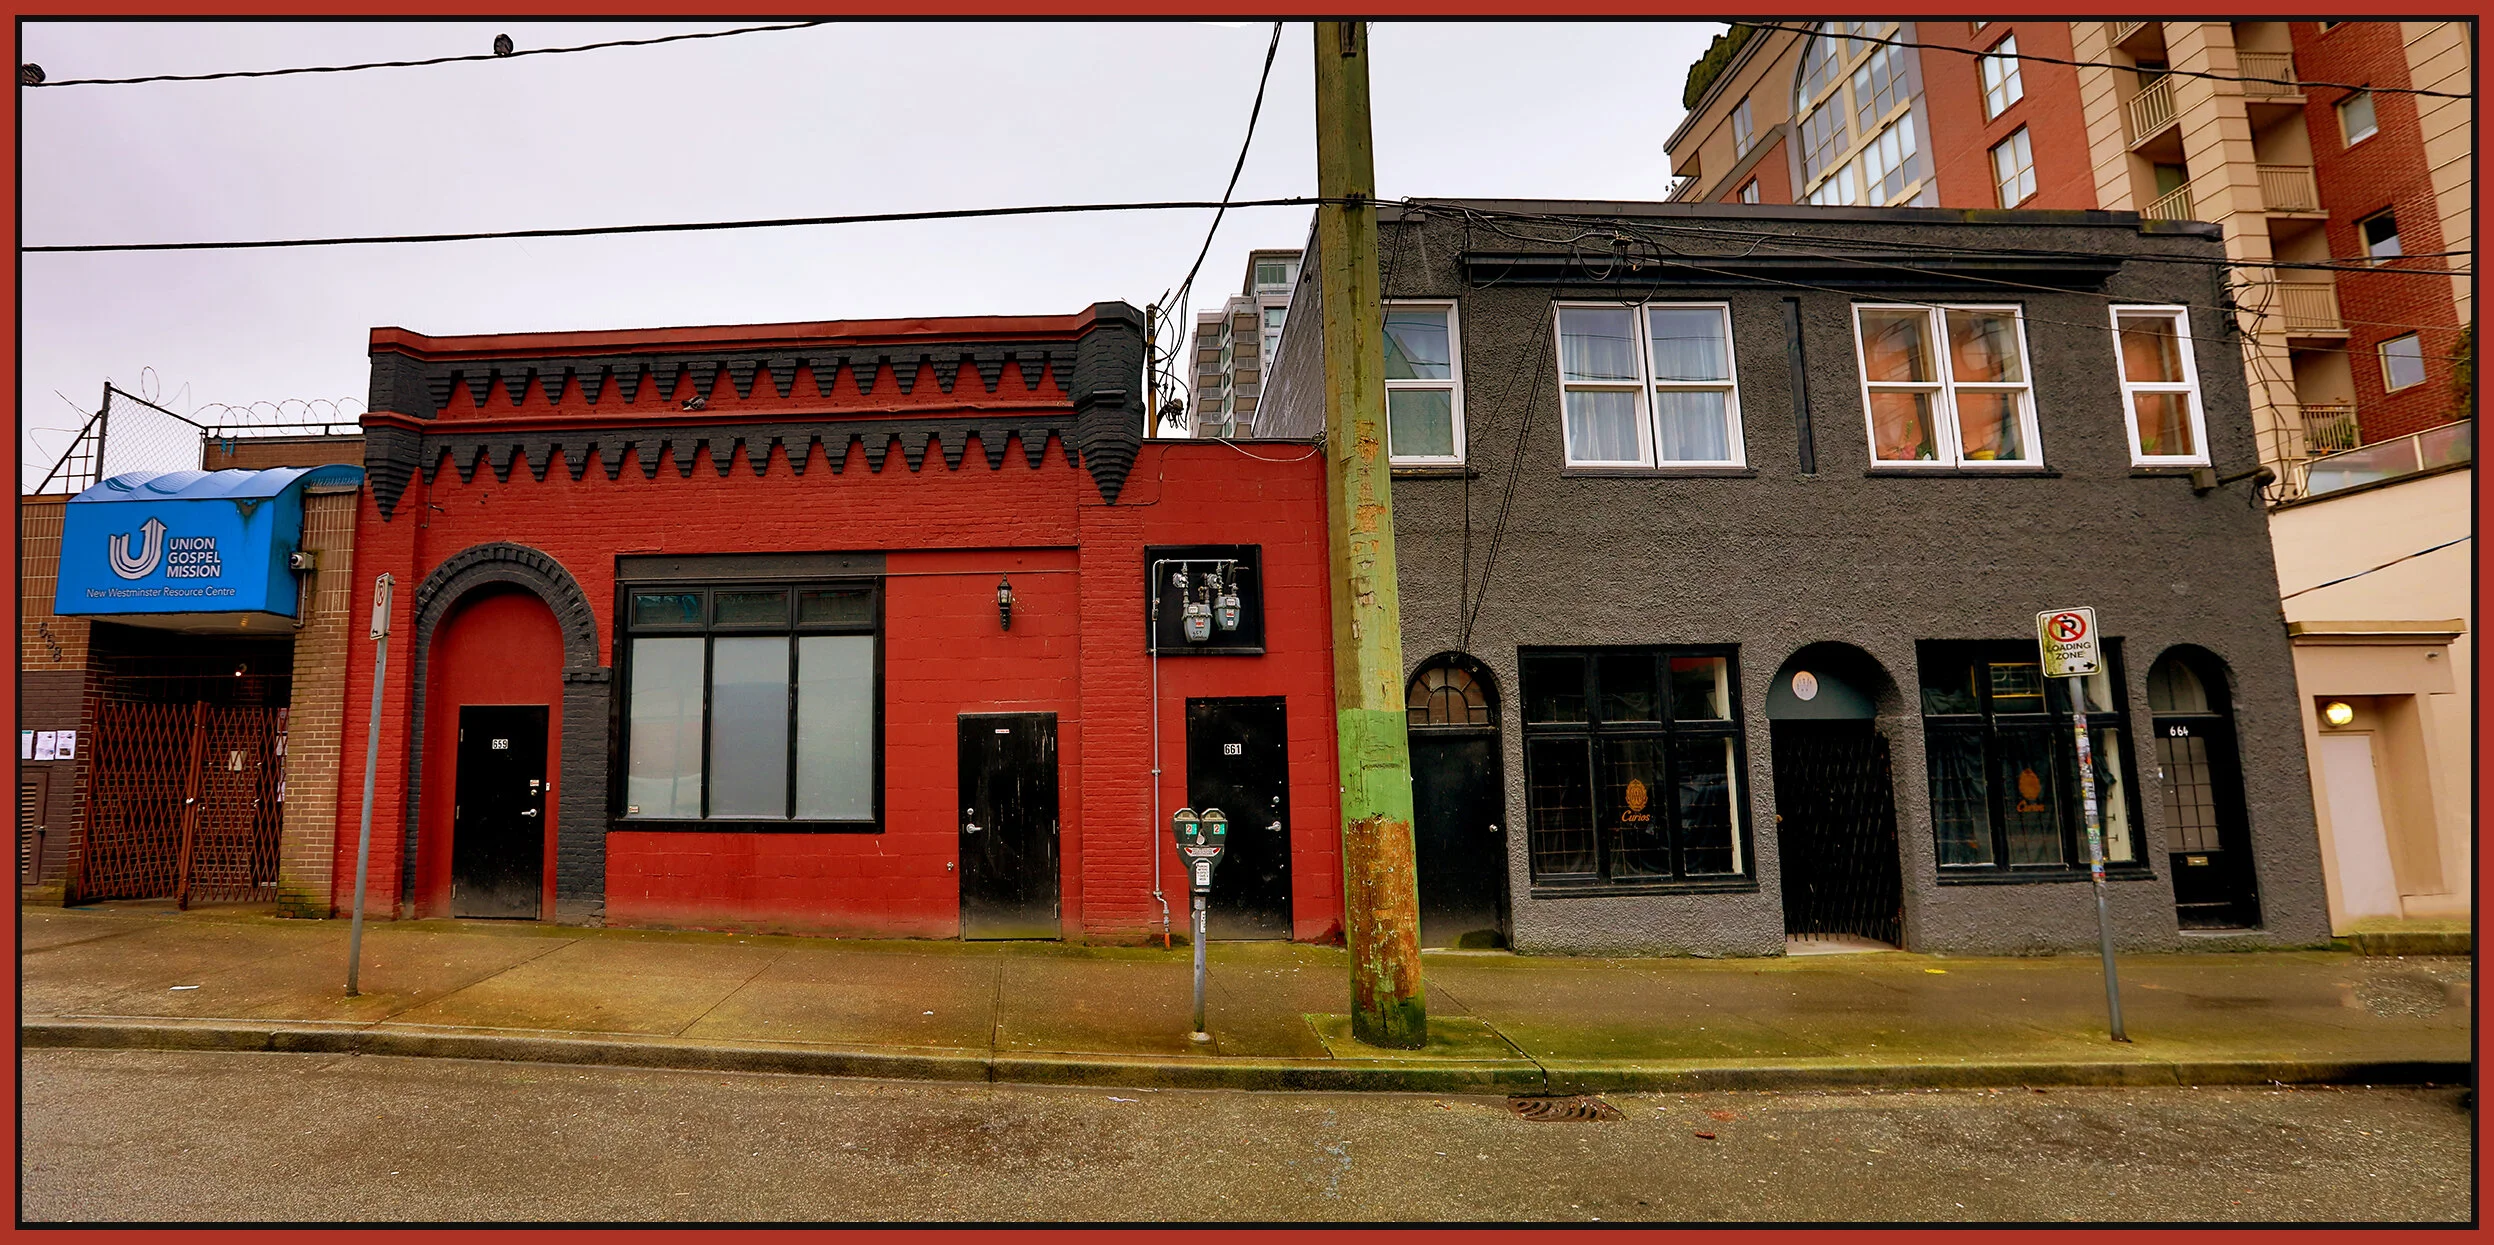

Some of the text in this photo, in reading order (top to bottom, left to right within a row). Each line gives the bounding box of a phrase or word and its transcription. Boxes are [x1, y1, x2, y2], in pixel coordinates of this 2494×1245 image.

[169, 537, 216, 550] UNION
[168, 551, 221, 564] GOSPEL
[166, 565, 221, 578] MISSION
[86, 586, 236, 598] New Westminster Resource Centre
[2046, 641, 2092, 653] LOADING
[2055, 651, 2085, 661] ZONE
[2170, 725, 2189, 737] 664
[493, 739, 508, 749] 659
[1224, 744, 1241, 755] 661
[1621, 809, 1651, 822] Curios
